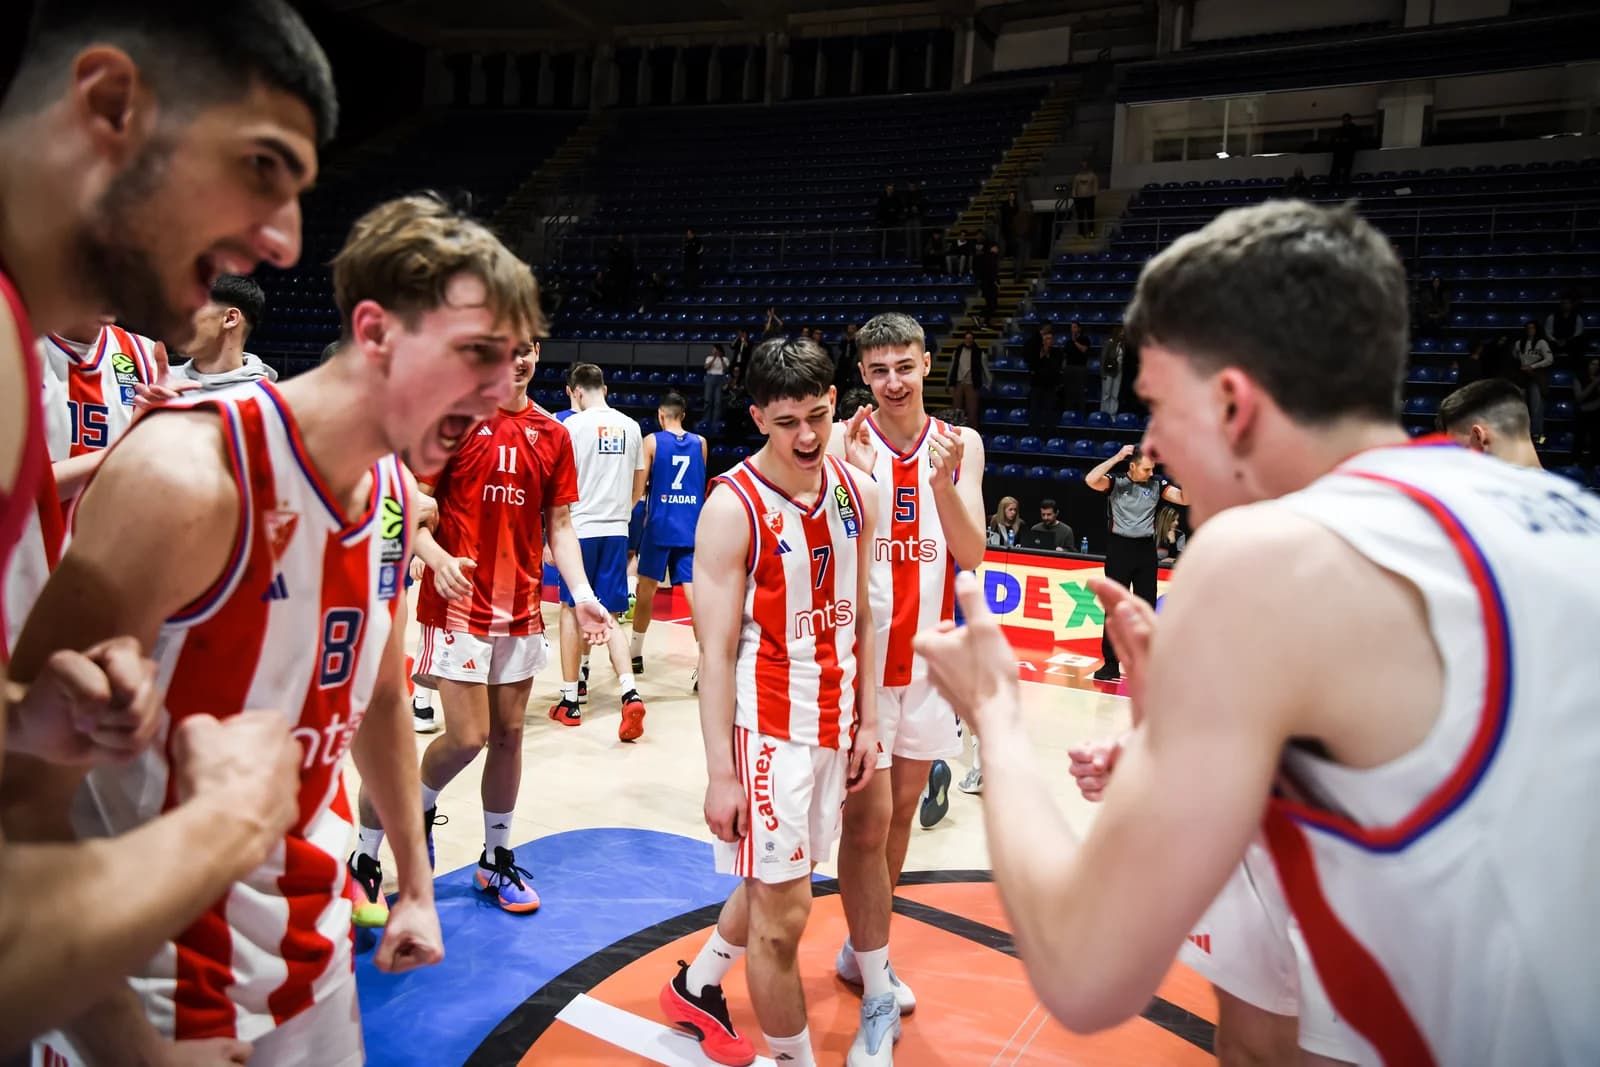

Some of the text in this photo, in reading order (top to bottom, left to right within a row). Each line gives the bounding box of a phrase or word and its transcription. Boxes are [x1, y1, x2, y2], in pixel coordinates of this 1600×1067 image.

[67, 400, 109, 448] 15
[496, 444, 518, 474] 11
[671, 455, 690, 490] 7
[482, 483, 526, 506] mts
[668, 494, 697, 504] ZADAR
[895, 487, 916, 522] 5
[875, 535, 938, 563] mts
[811, 545, 831, 590] 7
[795, 599, 854, 639] mts
[319, 607, 365, 690] 8
[753, 741, 780, 832] carnex
